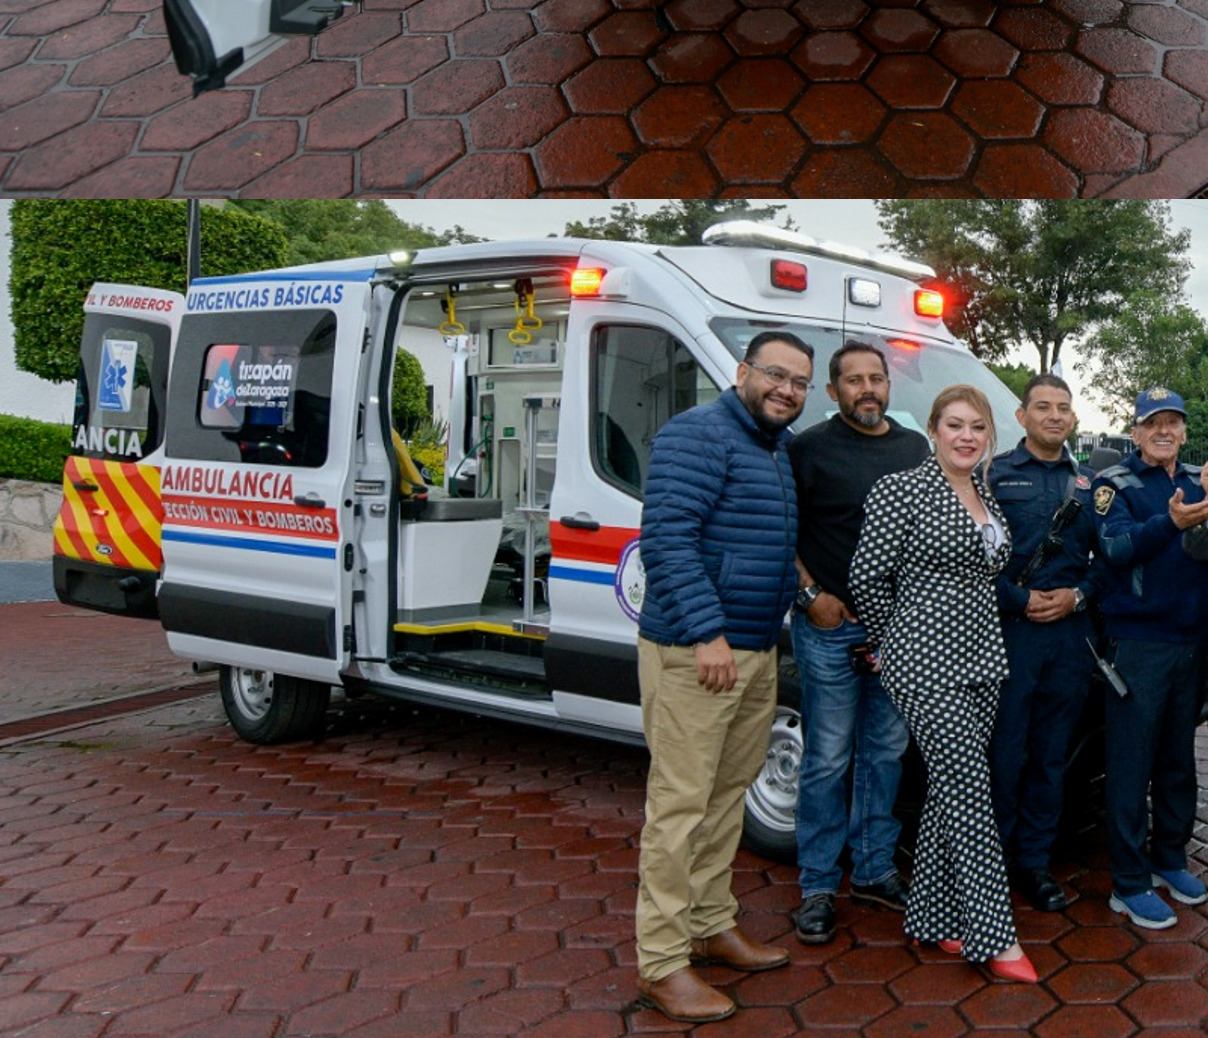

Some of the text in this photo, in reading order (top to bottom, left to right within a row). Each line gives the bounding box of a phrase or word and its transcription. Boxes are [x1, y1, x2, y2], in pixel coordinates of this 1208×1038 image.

[100, 295, 107, 306] Y
[108, 295, 174, 312] BOMBEROS
[187, 282, 344, 311] URGENCIAS BÁSICAS
[71, 424, 143, 458] ANCIA
[162, 465, 294, 501] AMBULANCIA
[161, 501, 334, 534] ECCIÓN CIVIL Y BOMBEROS
